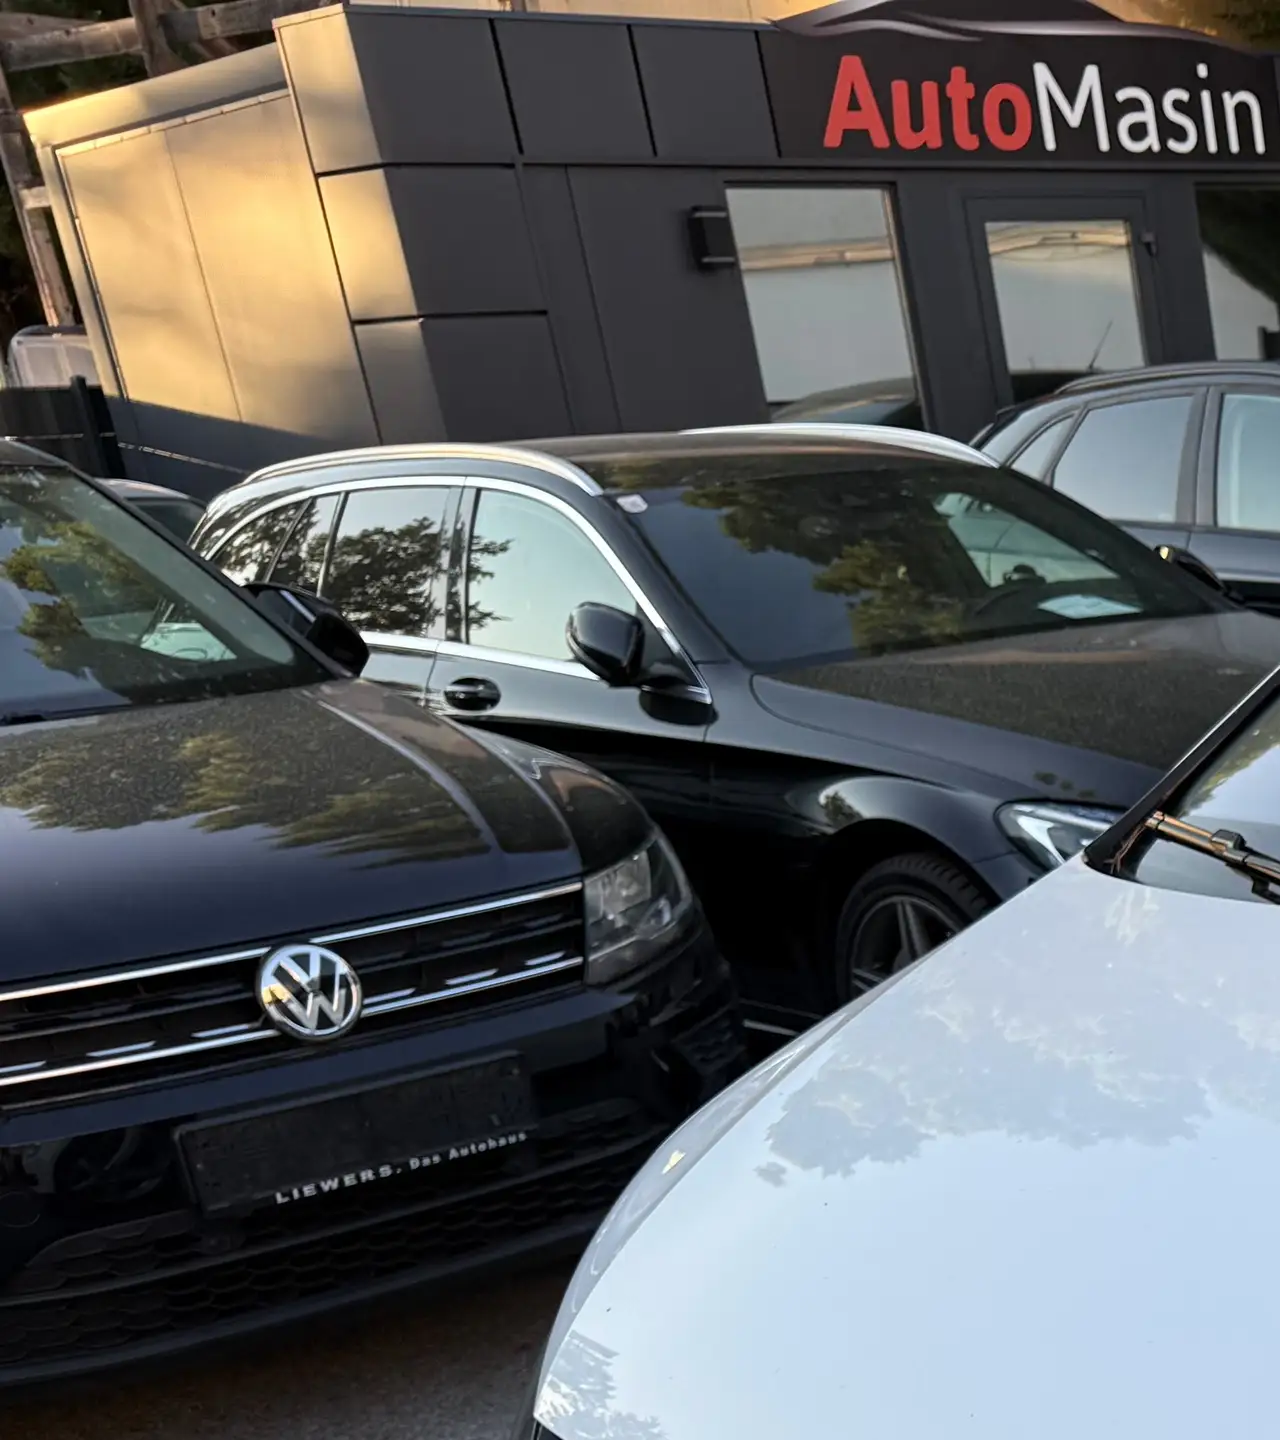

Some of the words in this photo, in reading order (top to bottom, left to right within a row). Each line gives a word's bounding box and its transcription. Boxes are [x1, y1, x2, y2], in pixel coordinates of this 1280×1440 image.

[823, 55, 1266, 155] AutoMasin
[261, 945, 361, 1038] VW
[408, 1153, 442, 1170] Das
[447, 1131, 527, 1161] Autohaus
